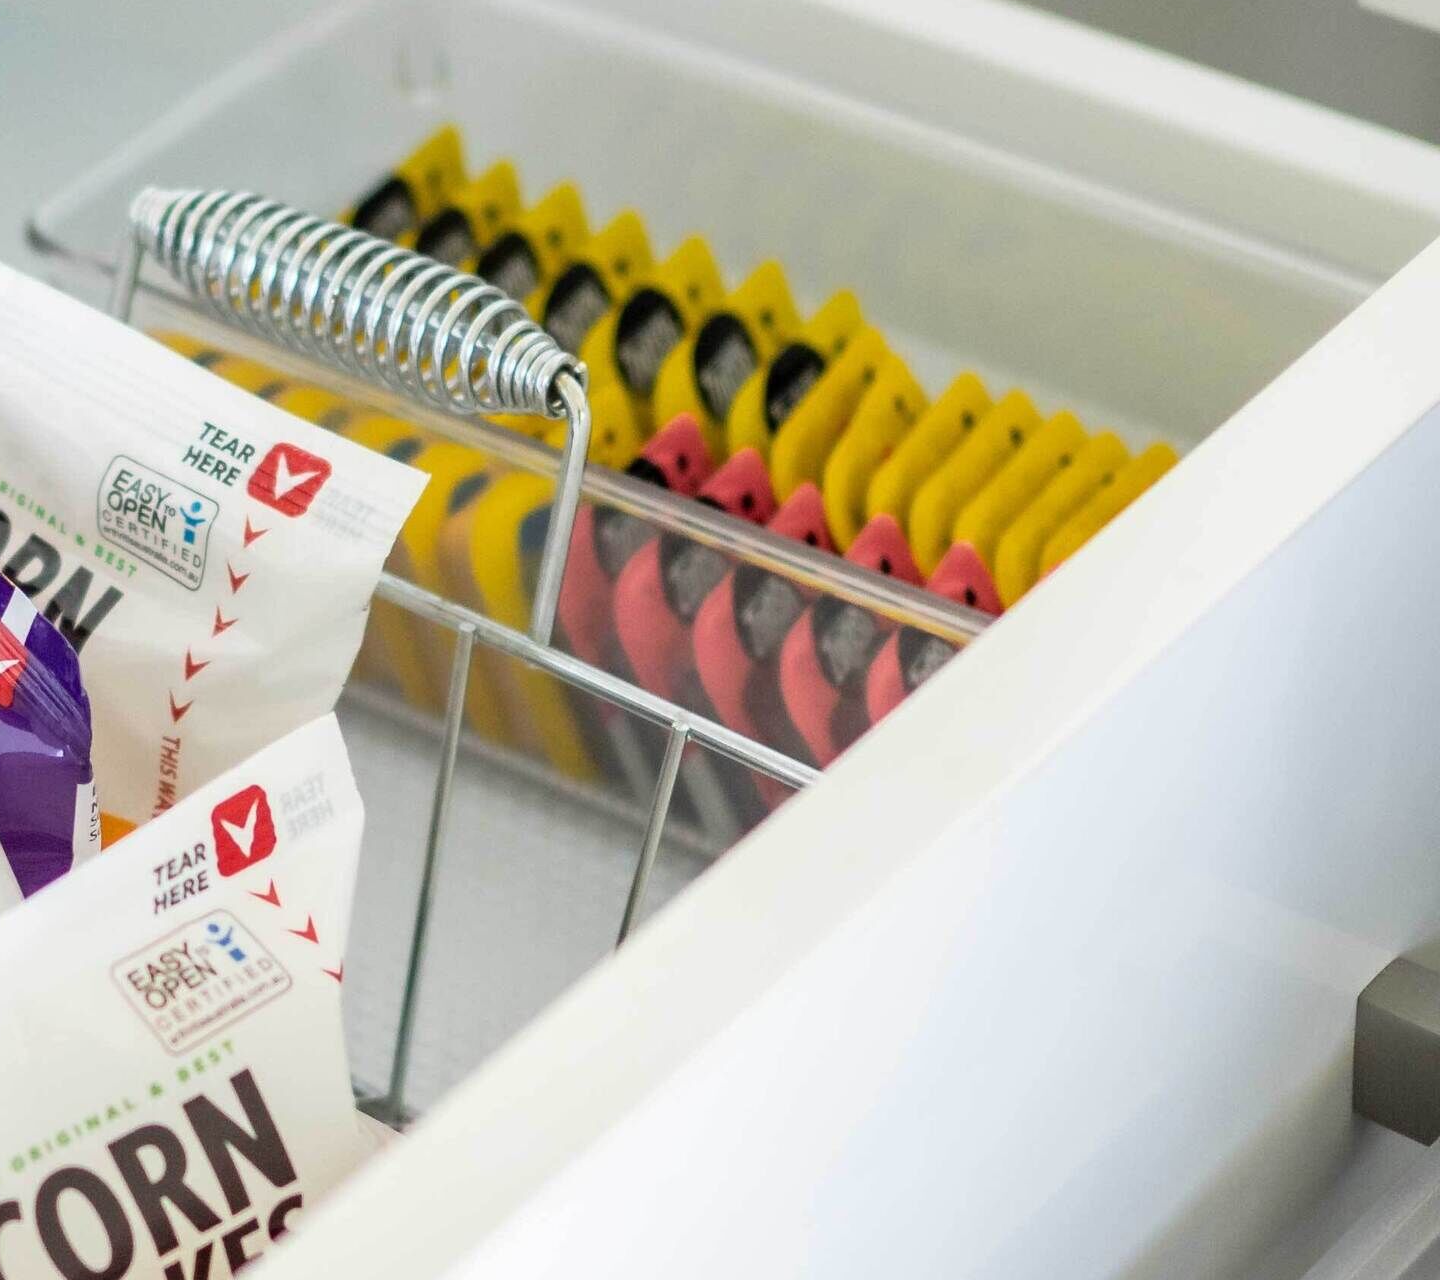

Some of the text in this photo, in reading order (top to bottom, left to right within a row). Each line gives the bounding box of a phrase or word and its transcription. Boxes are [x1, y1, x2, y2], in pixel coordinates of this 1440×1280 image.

[182, 445, 243, 487] HERE
[197, 421, 256, 464] TEAR
[106, 490, 169, 534] OPEN
[112, 468, 177, 518] EASY TO
[94, 543, 138, 579] BEST
[101, 508, 203, 570] CERTIFIED
[151, 736, 181, 819] THIS WA
[152, 841, 207, 887] TEAR
[153, 870, 210, 916] HERE
[126, 941, 193, 994] EASY
[144, 958, 217, 1010] OPEN
[9, 1095, 138, 1173] ORIGINAL
[174, 1037, 239, 1083] BEST
